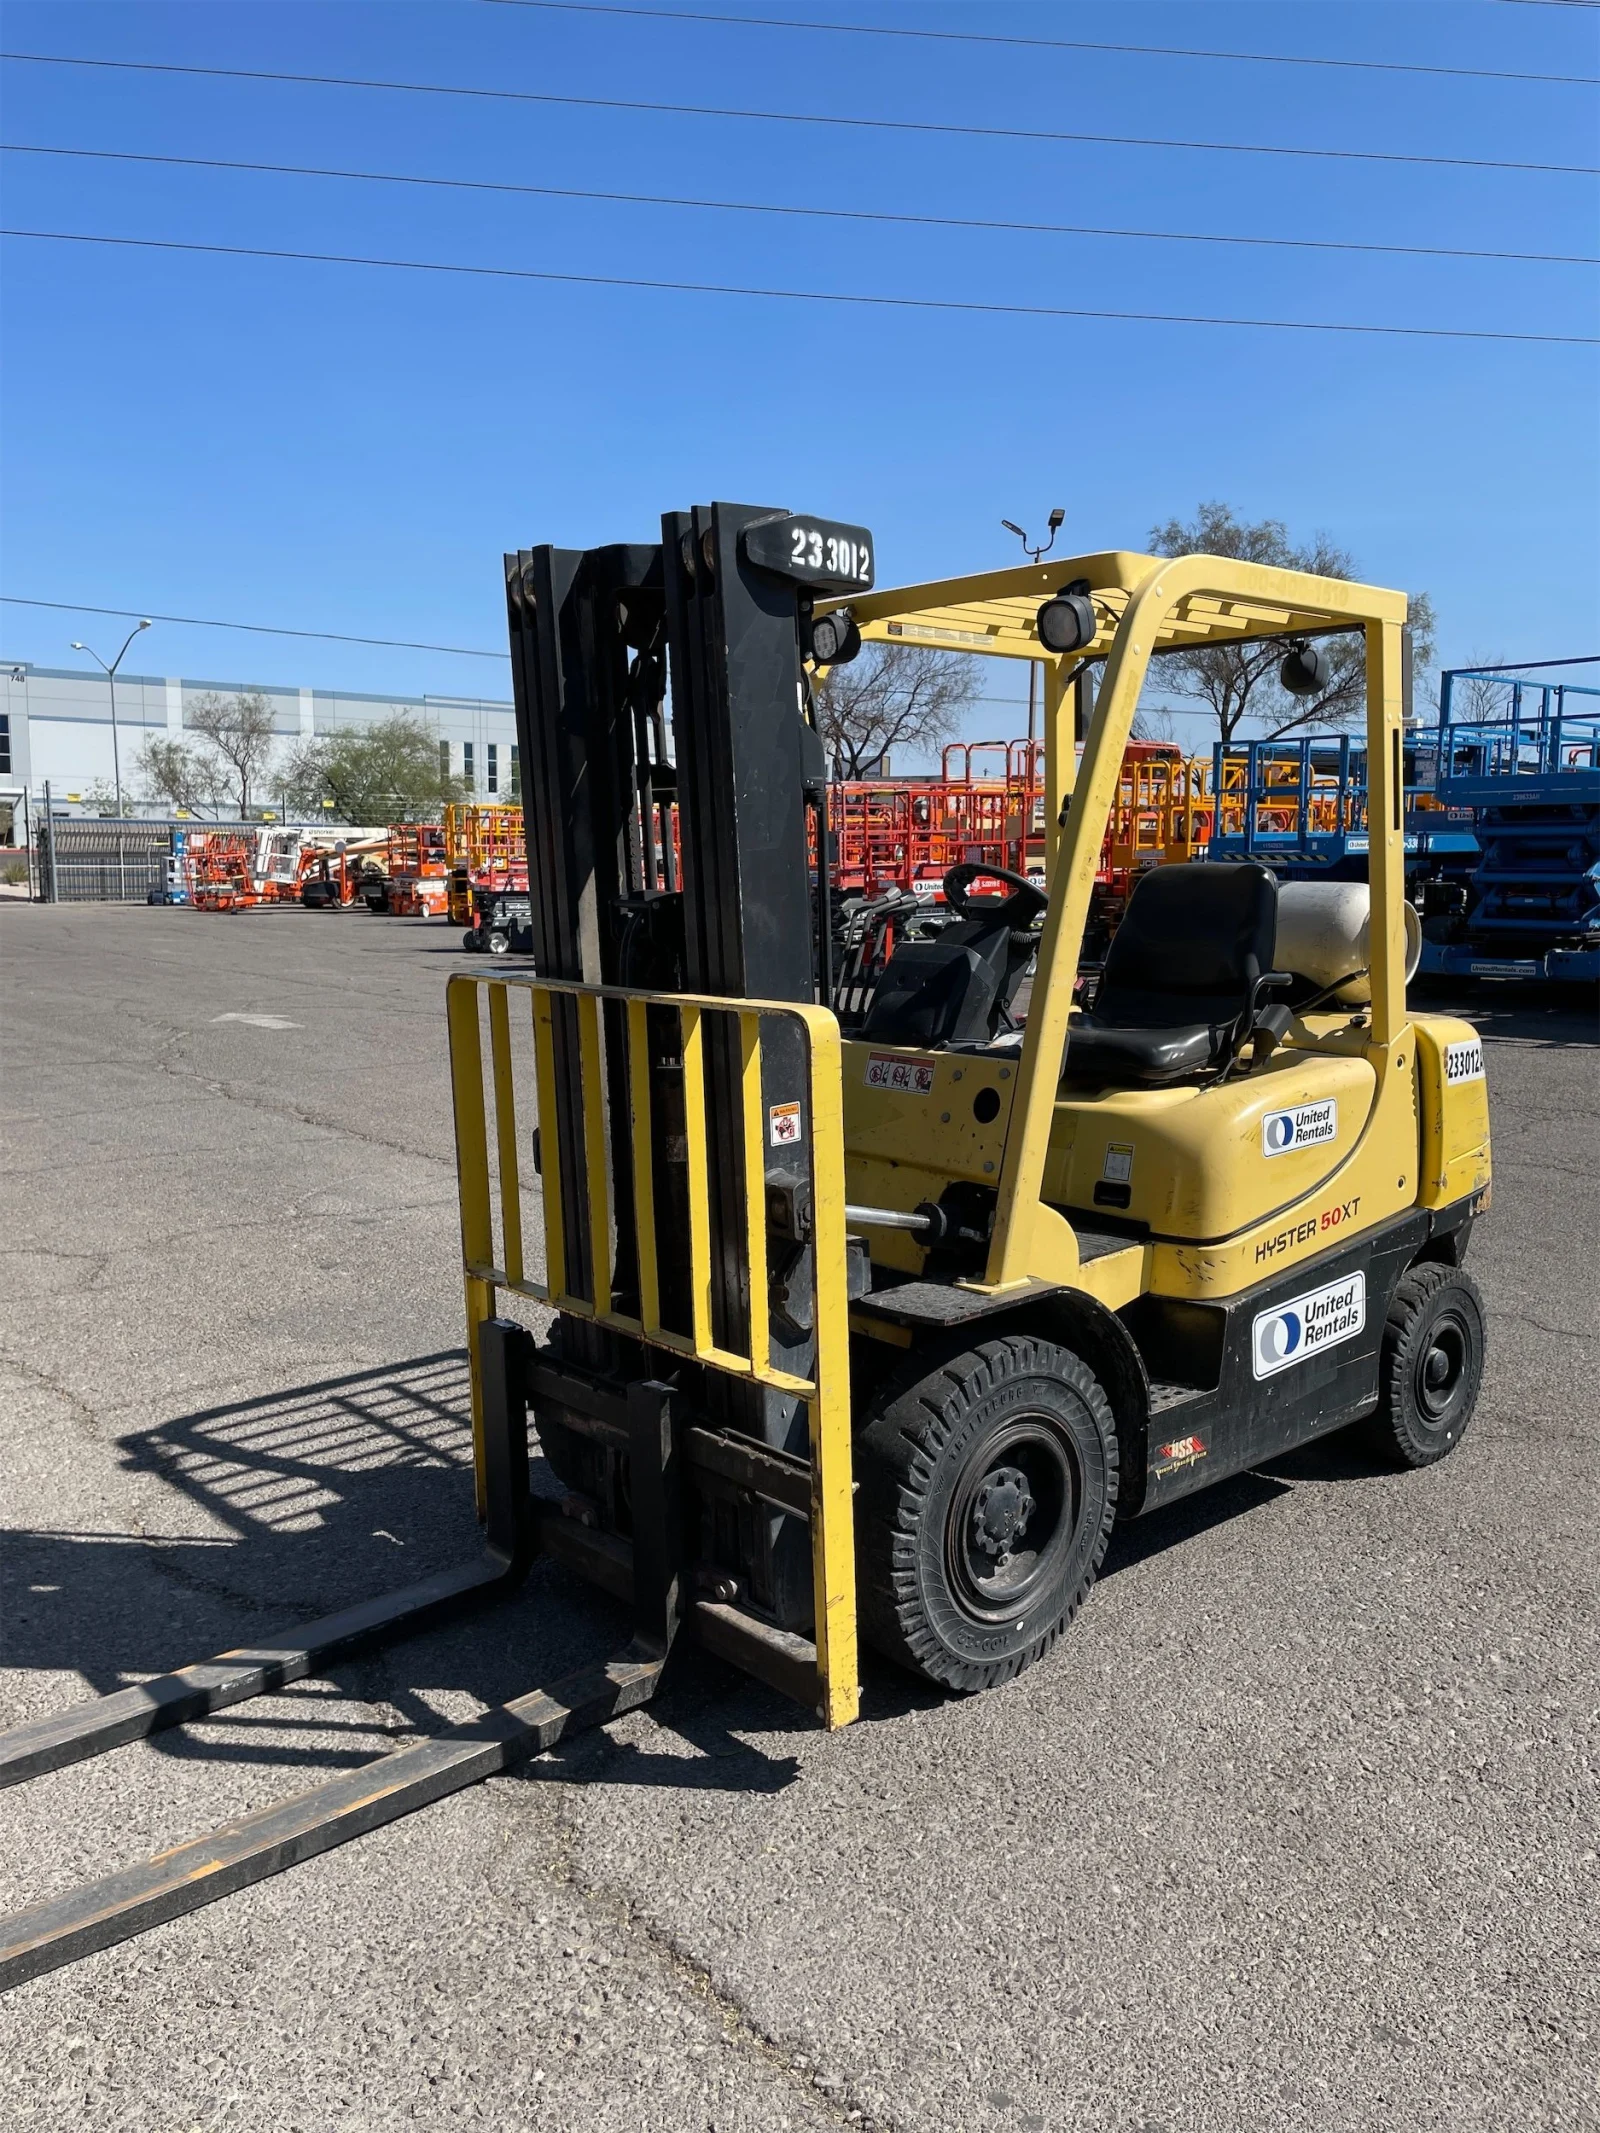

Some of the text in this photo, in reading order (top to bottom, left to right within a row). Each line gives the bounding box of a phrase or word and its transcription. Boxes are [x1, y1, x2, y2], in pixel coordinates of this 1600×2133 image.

[1140, 860, 1159, 868] JCB
[1296, 1105, 1331, 1127] United
[1295, 1122, 1333, 1143] Rentals
[1255, 1197, 1361, 1264] HYSTER 50XT
[1305, 1285, 1354, 1324] United
[1304, 1307, 1359, 1347] Rentals
